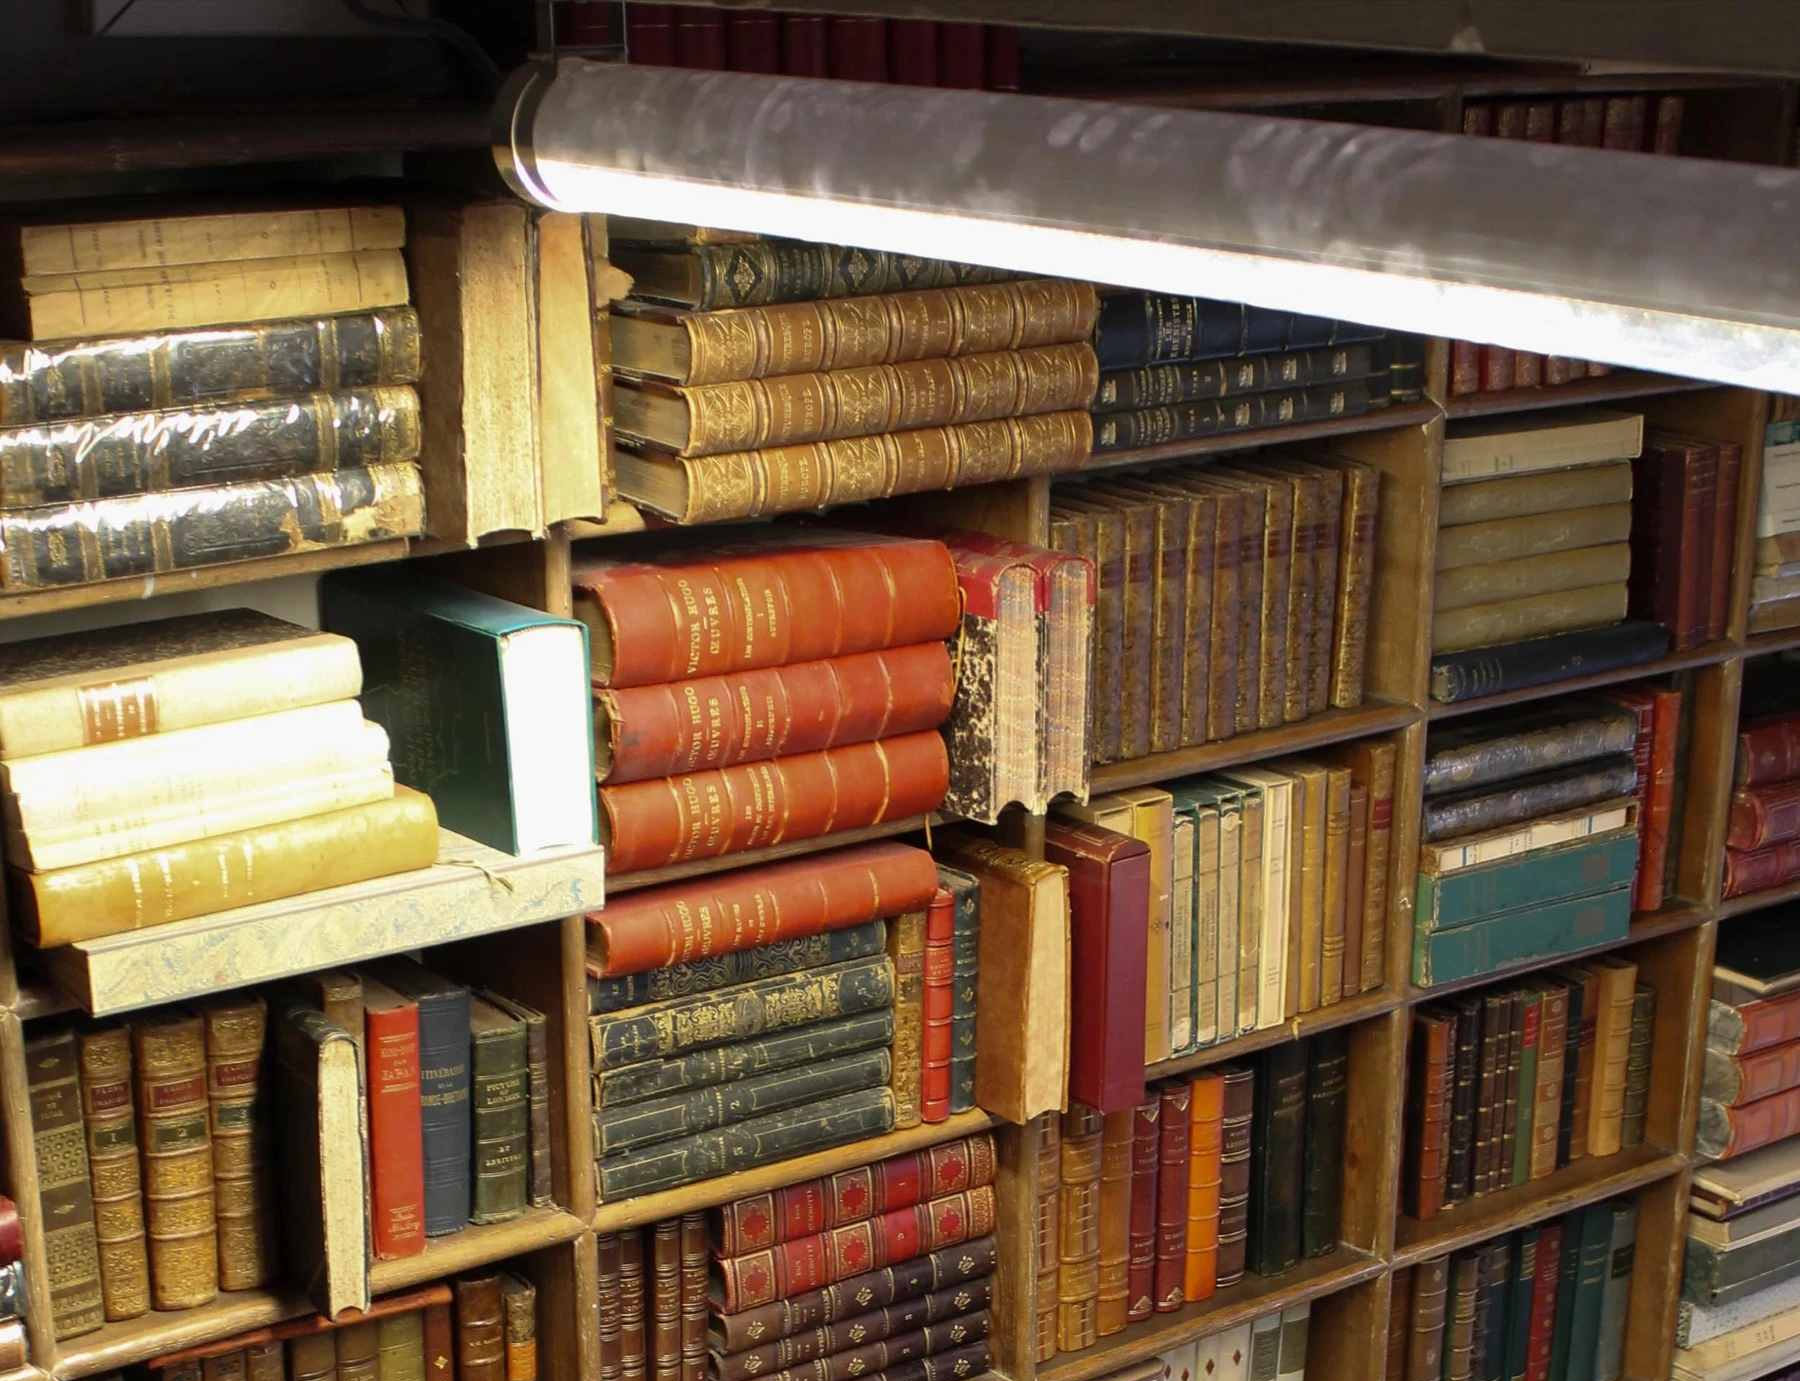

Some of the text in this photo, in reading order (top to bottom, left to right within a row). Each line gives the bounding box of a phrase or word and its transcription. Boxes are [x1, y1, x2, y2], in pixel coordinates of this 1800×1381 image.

[678, 580, 700, 675] VICTOR HUGO
[684, 687, 702, 724] HUGO
[682, 777, 701, 815] HUGO
[676, 900, 694, 932] HUGO
[487, 1093, 521, 1105] LONDON
[730, 1100, 740, 1109] 2
[178, 1127, 187, 1137] 2
